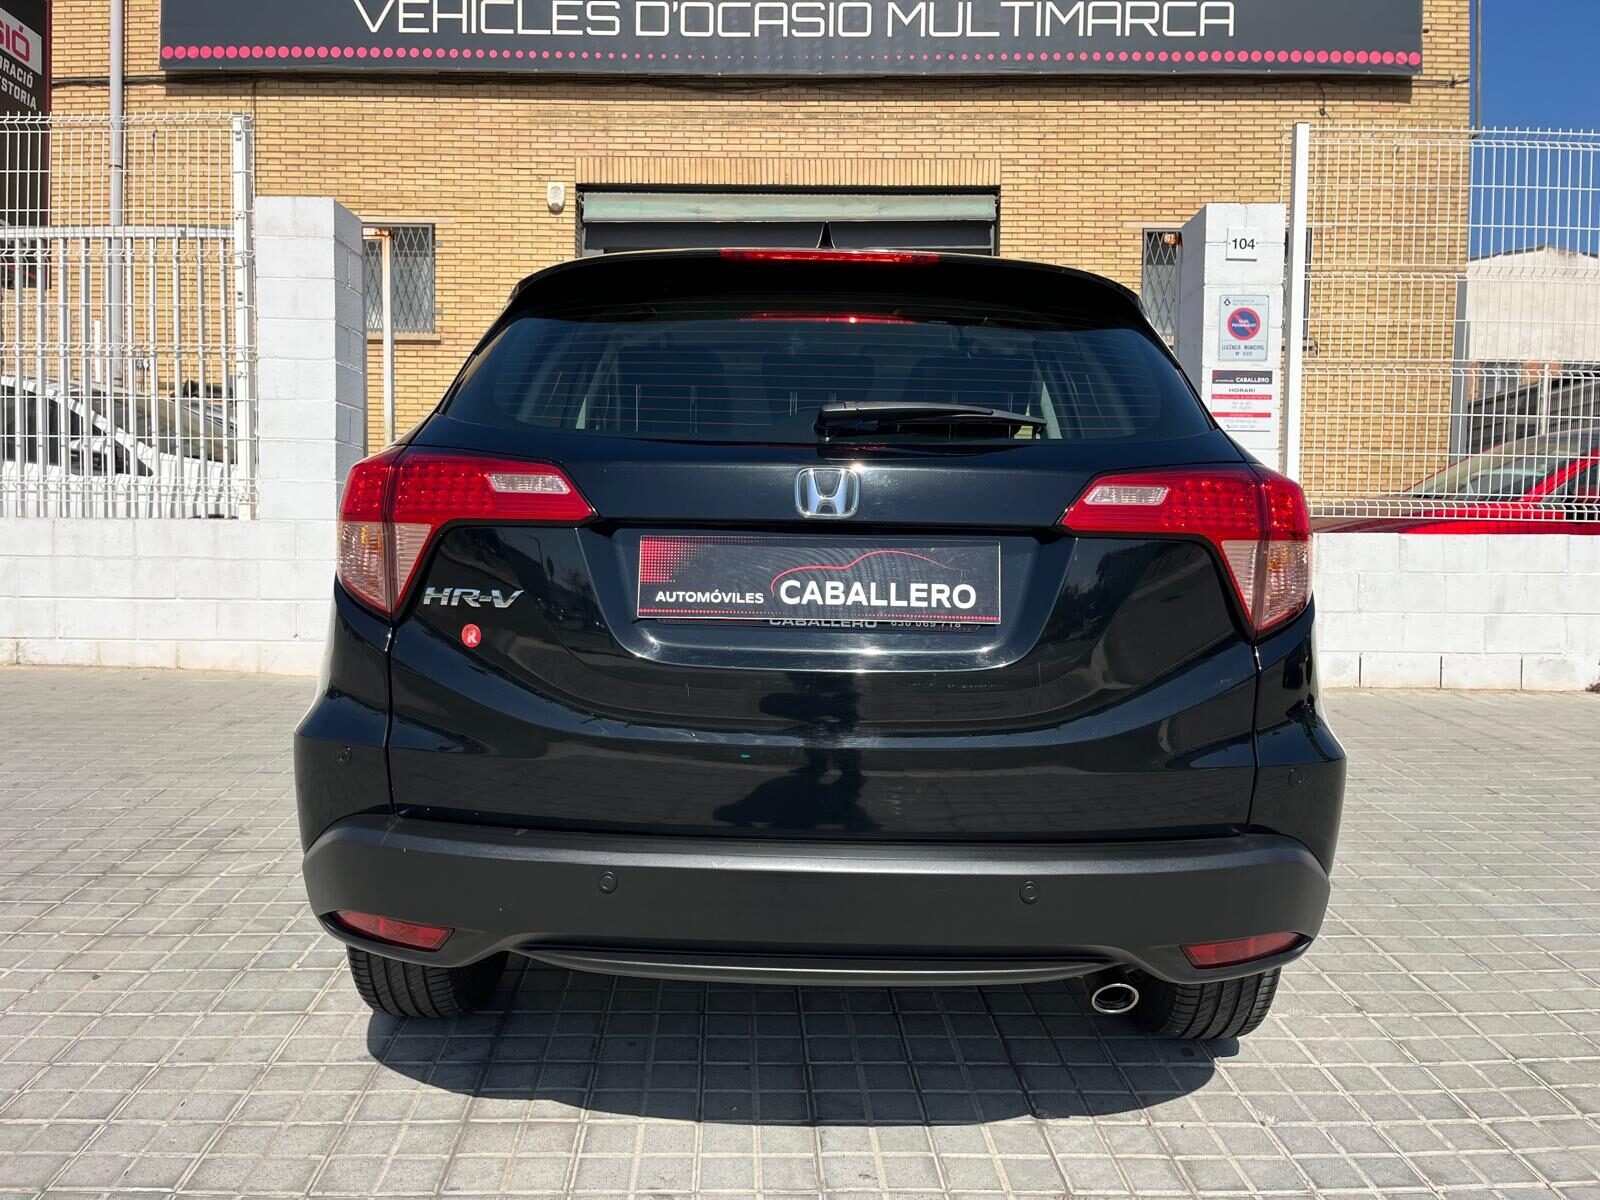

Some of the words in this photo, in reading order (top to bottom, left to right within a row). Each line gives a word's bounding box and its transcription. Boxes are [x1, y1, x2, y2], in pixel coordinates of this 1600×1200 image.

[353, 0, 620, 35] VEHICLES
[887, 2, 1235, 37] MULTIMARCA
[0, 76, 37, 111] STORIA
[1232, 238, 1255, 250] 104
[423, 587, 524, 608] HR-V
[655, 589, 765, 604] AUTOMÓVILES
[779, 580, 977, 609] CABALLERO
